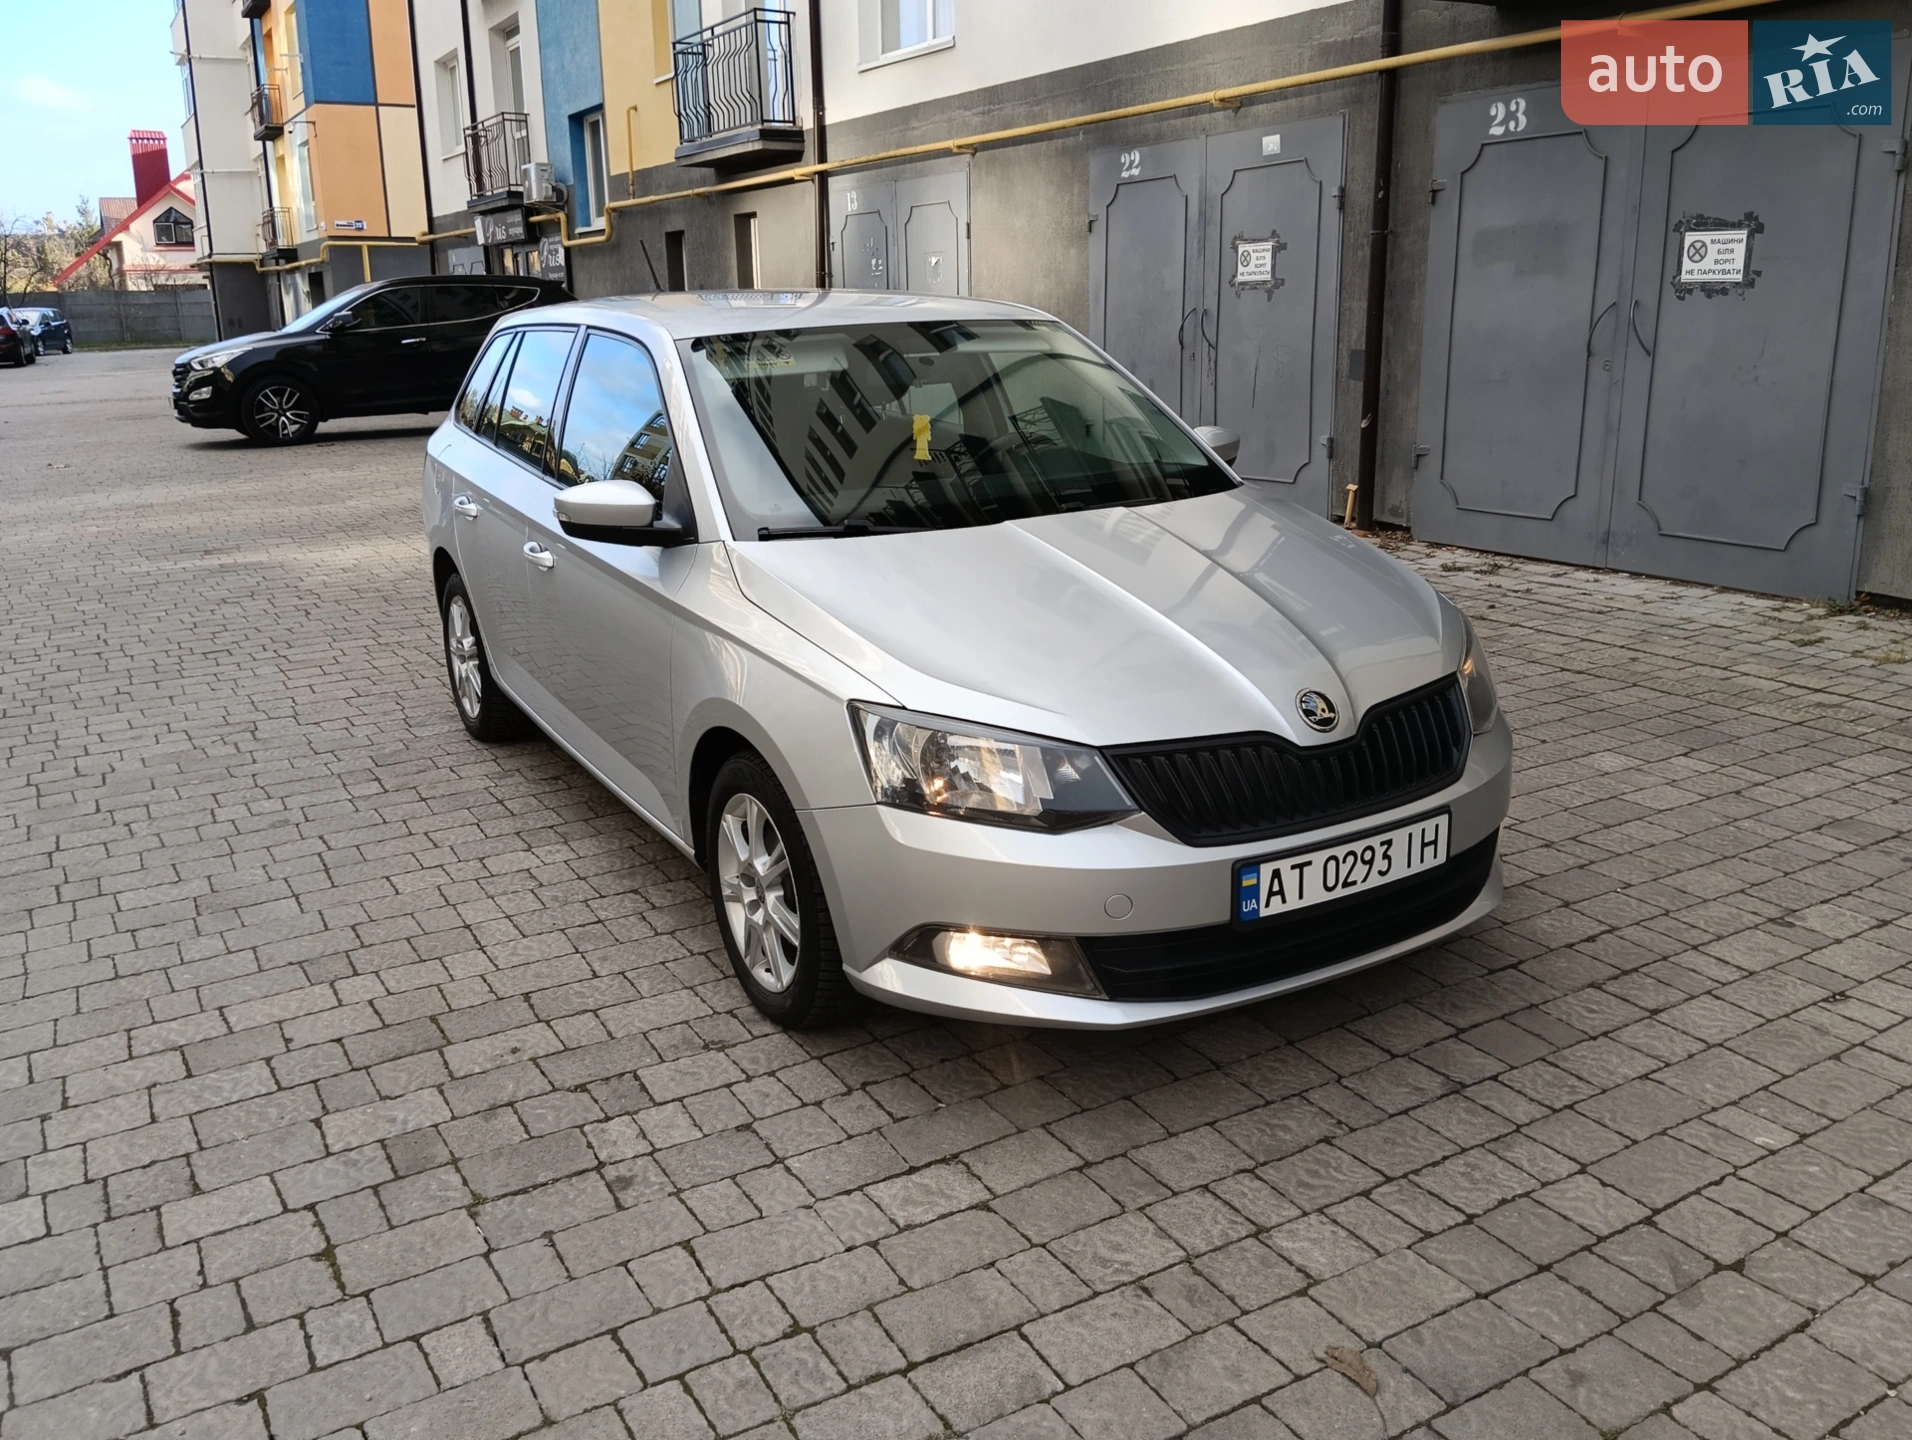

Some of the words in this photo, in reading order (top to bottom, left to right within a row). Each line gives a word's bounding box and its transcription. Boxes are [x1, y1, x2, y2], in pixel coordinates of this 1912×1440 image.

[1489, 98, 1527, 135] 23
[1121, 150, 1141, 178] 22
[847, 191, 858, 212] 13
[1697, 268, 1741, 276] ПАРКУВАТИ
[1713, 258, 1735, 266] ВОРІТ
[1264, 860, 1313, 908] AT
[1322, 838, 1393, 893] 0293
[1407, 823, 1440, 869] IH
[1242, 898, 1258, 912] UA
